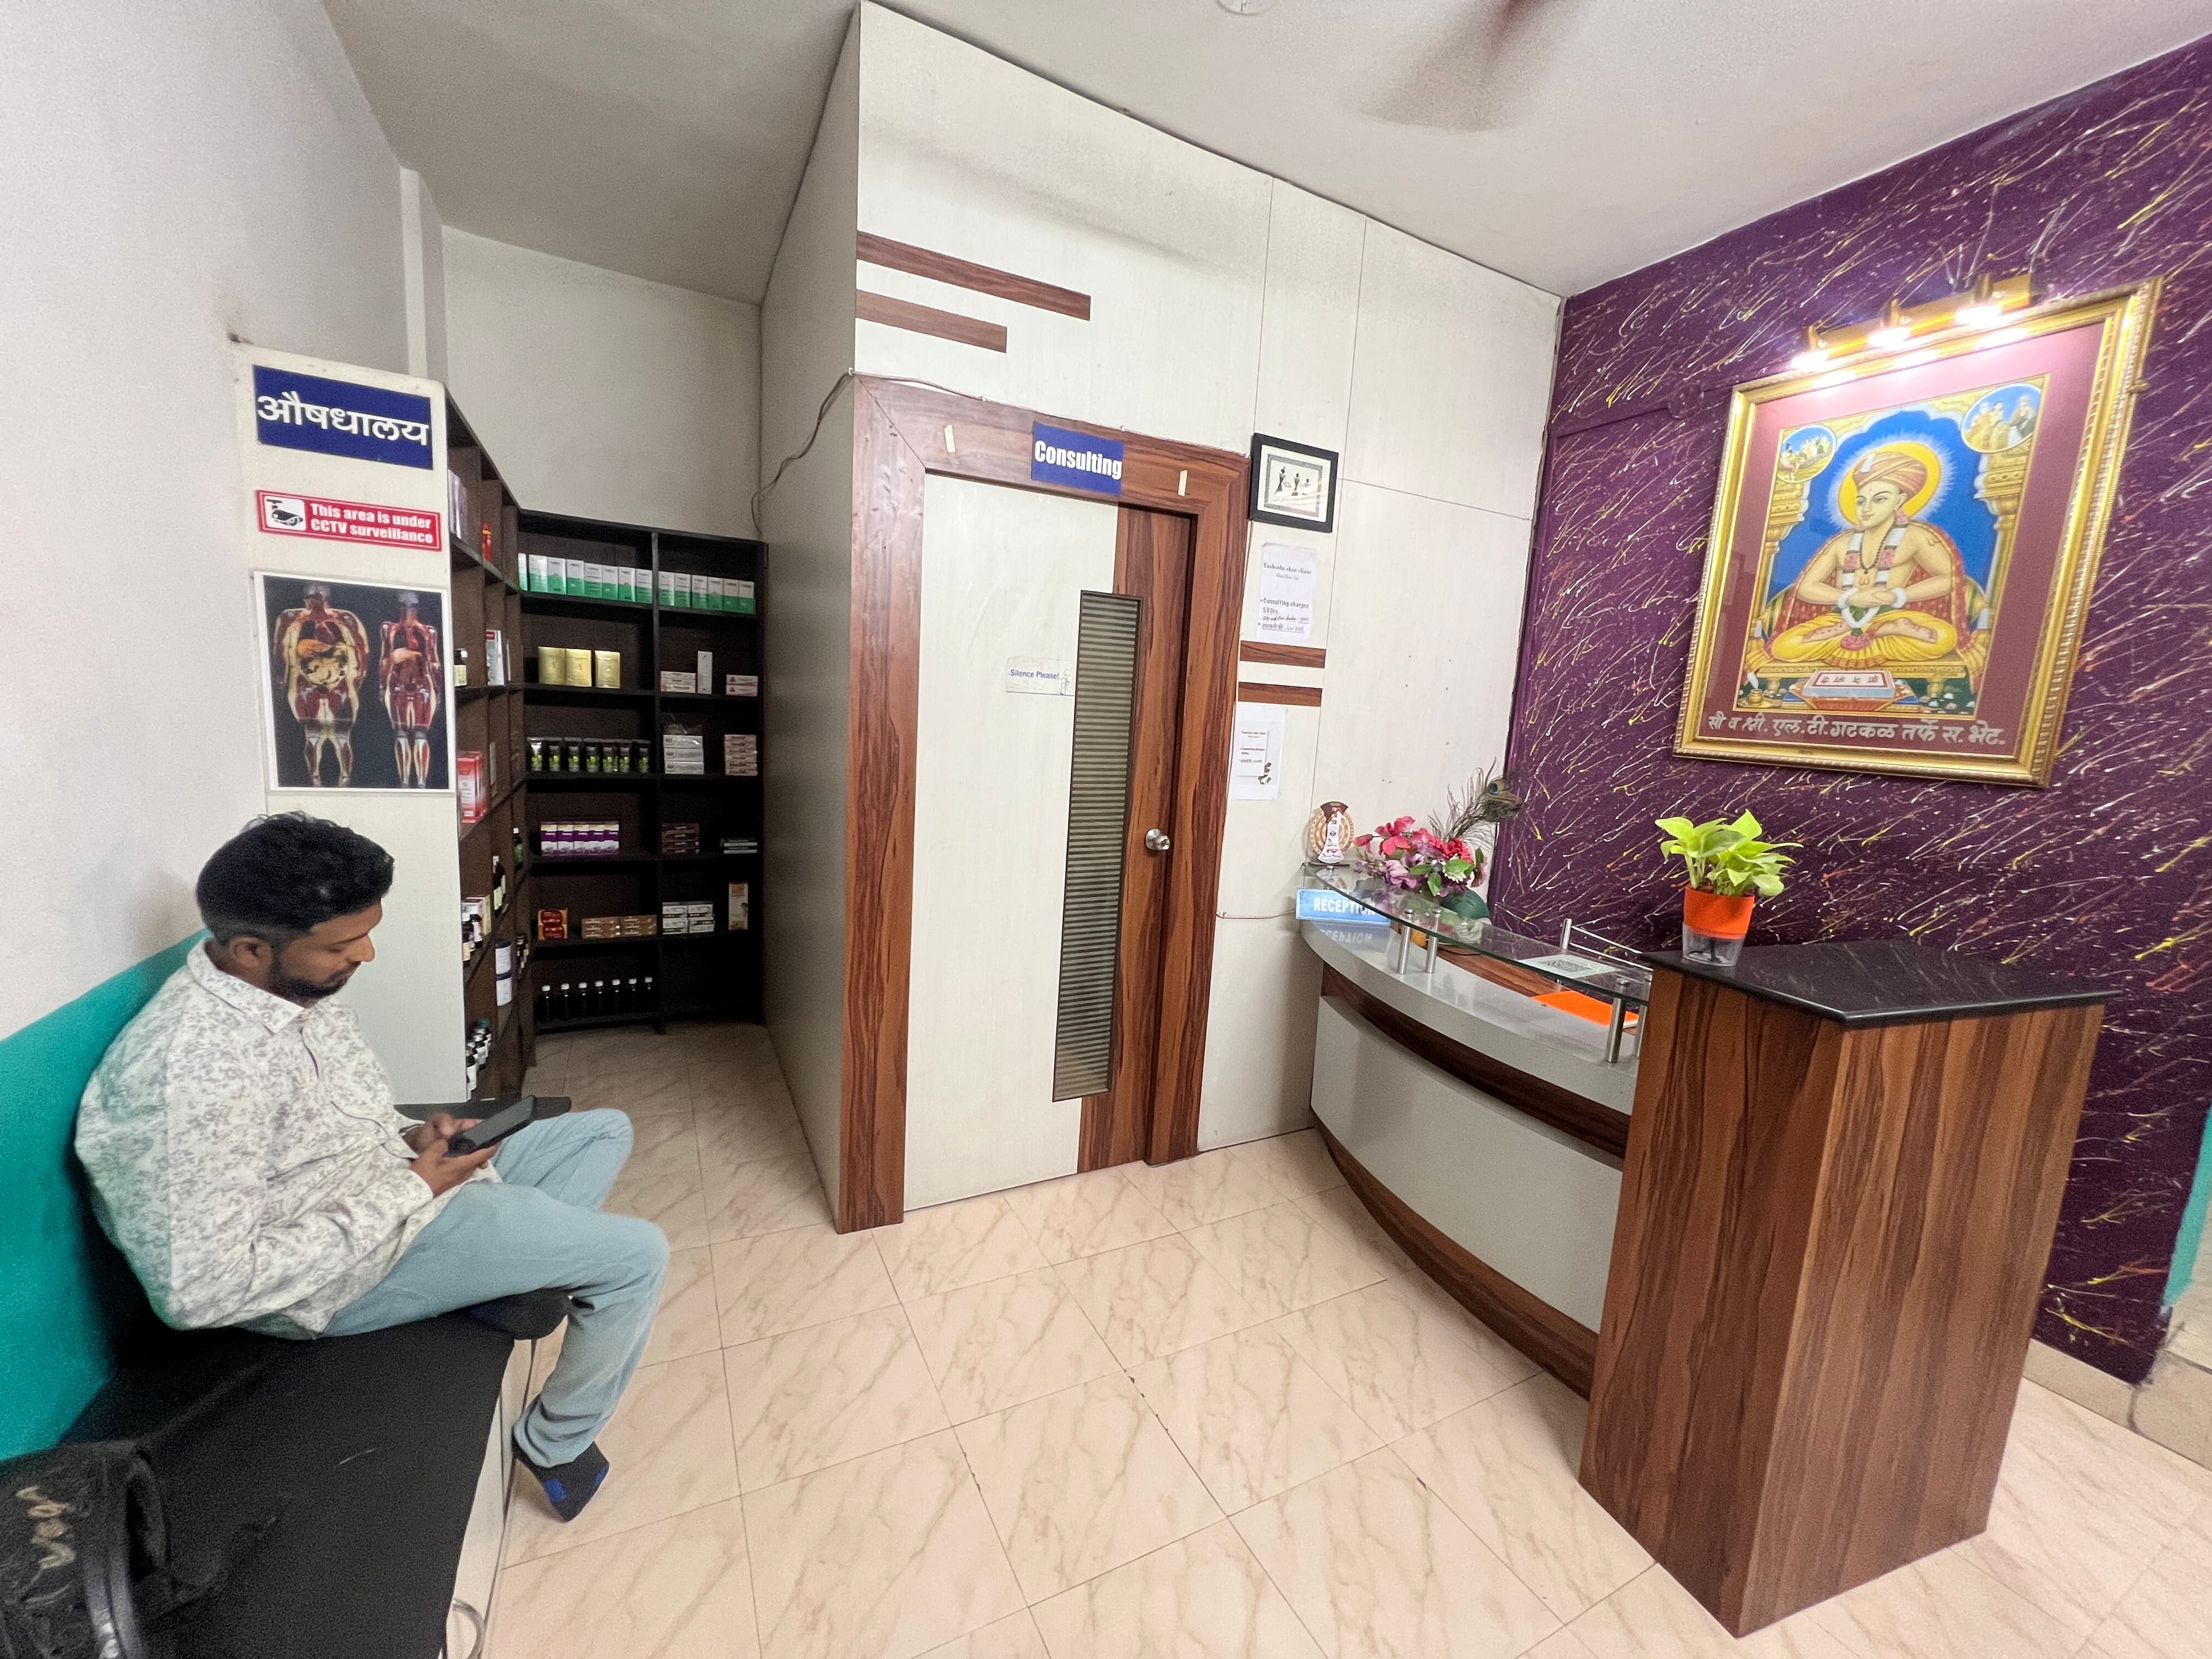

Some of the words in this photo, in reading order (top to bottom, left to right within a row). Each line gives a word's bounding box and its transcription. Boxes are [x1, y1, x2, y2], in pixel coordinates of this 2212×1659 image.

[257, 391, 429, 446] औषधालय
[1035, 440, 1123, 480] Consulting
[310, 503, 340, 518] This
[343, 509, 375, 523] area
[377, 511, 390, 524] is
[392, 514, 431, 529] under
[310, 518, 347, 534] CCTV
[350, 524, 433, 544] surveillance
[1263, 597, 1289, 607] Consulting
[1290, 601, 1309, 609] charges
[1010, 669, 1035, 678] Silence
[1036, 671, 1059, 680] Please!
[1728, 717, 1743, 731] व
